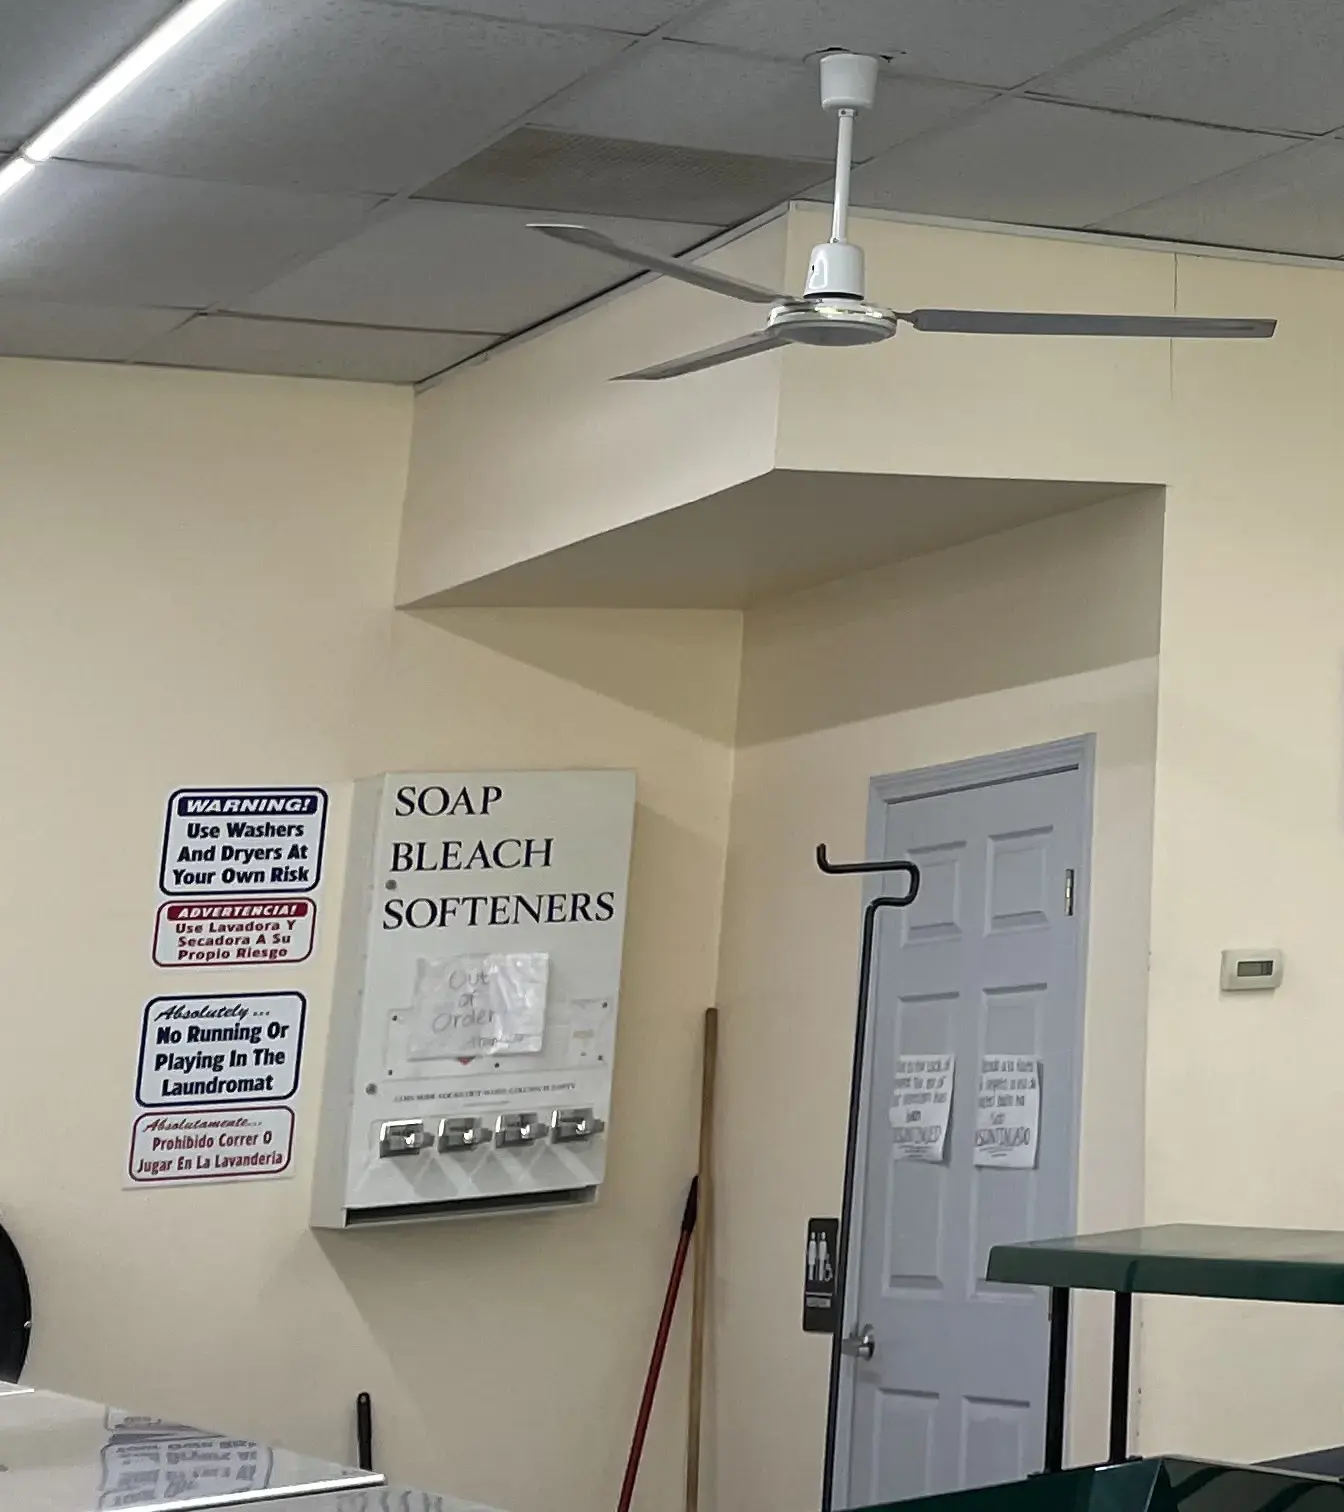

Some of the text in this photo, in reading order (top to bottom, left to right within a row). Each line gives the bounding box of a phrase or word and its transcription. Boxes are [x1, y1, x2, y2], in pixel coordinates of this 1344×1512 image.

[187, 799, 311, 812] WARNING!
[395, 786, 502, 816] SOAP
[187, 822, 304, 838] Use Washers
[177, 844, 308, 864] And Dryers At
[389, 838, 554, 872] BLEACH
[173, 866, 309, 885] Your Own Risk
[178, 905, 297, 918] ADVERTENCIA!
[383, 892, 615, 930] SOFTENERS
[176, 920, 296, 933] Use Lavadora Y
[178, 934, 291, 947] Secadora A Su
[178, 948, 288, 961] Propio Riesgo
[449, 970, 489, 989] Out
[458, 990, 477, 1007] of
[432, 1008, 494, 1033] Order
[156, 1022, 289, 1044] No Running Or
[154, 1048, 285, 1073] Playing In The
[162, 1074, 273, 1096] Laundromat
[152, 1131, 272, 1151] Prohibido Correr O
[137, 1159, 173, 1175] Jugar
[177, 1156, 192, 1170] En
[196, 1155, 210, 1169] La
